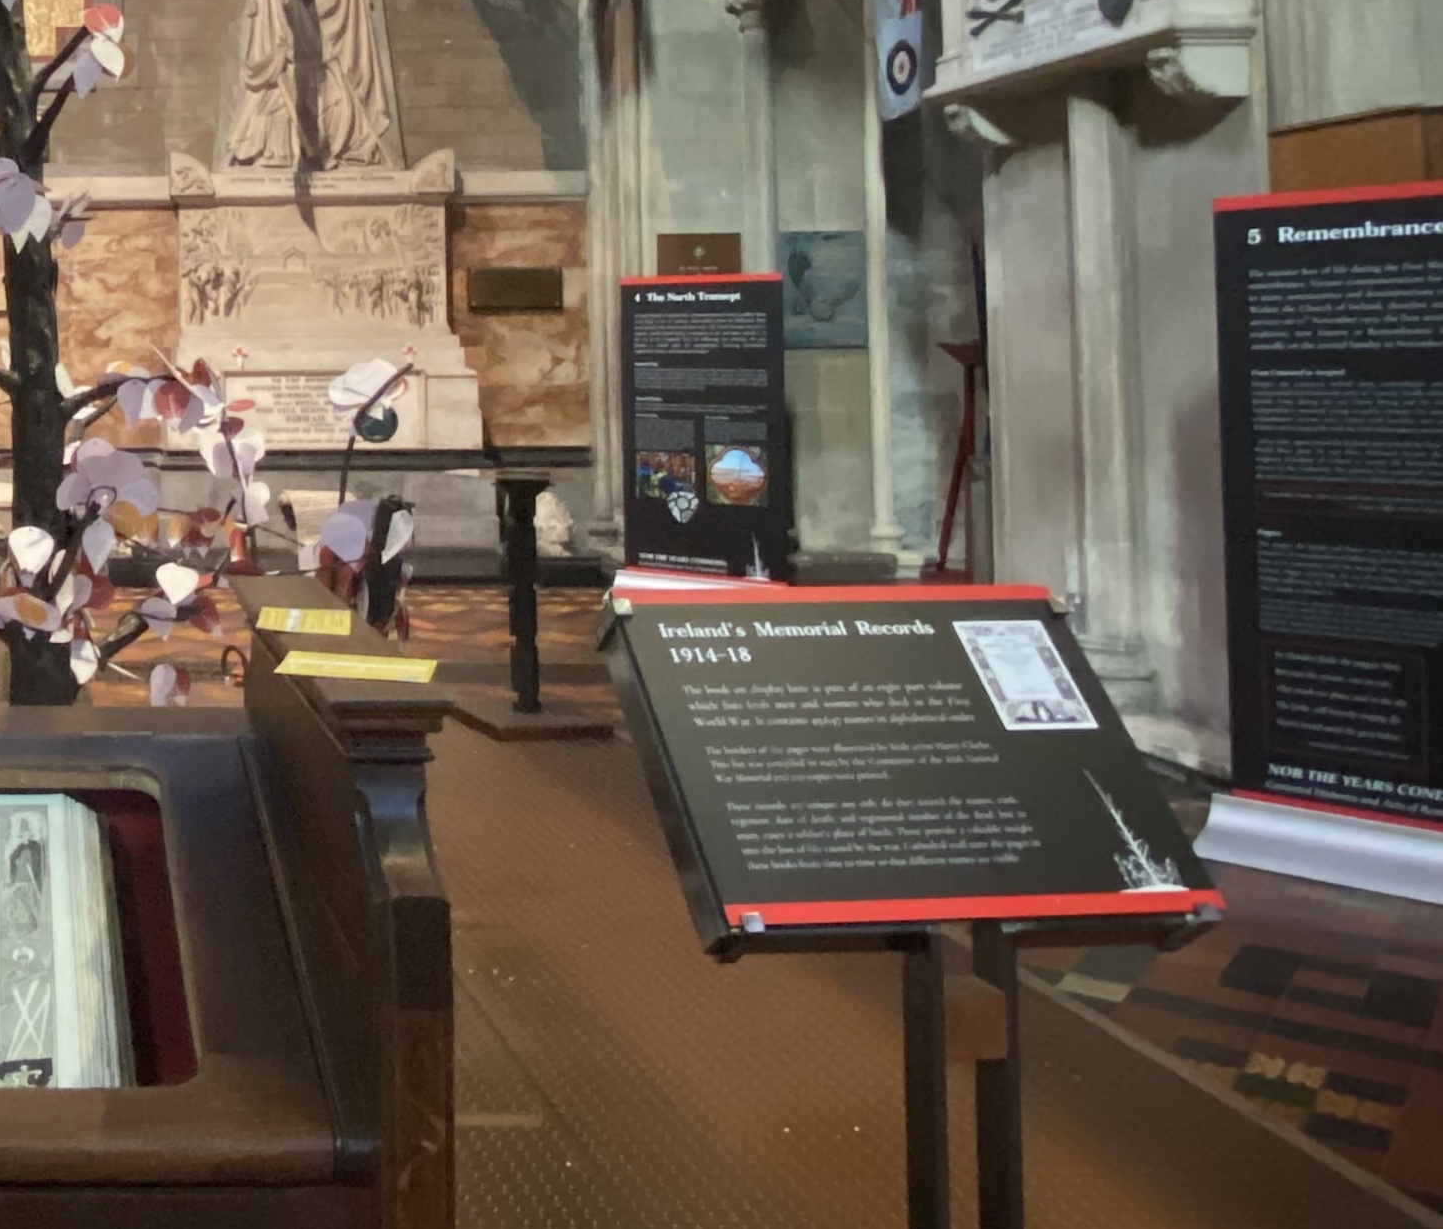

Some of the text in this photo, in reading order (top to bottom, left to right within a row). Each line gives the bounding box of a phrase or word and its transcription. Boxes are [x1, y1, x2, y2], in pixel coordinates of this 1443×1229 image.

[1247, 228, 1262, 245] 5
[634, 291, 741, 303] 4 The North Transept
[658, 620, 935, 639] Ireland's Memorial Records
[1268, 762, 1303, 779] NOR
[1308, 769, 1338, 783] THE
[1343, 775, 1393, 792] YEARS
